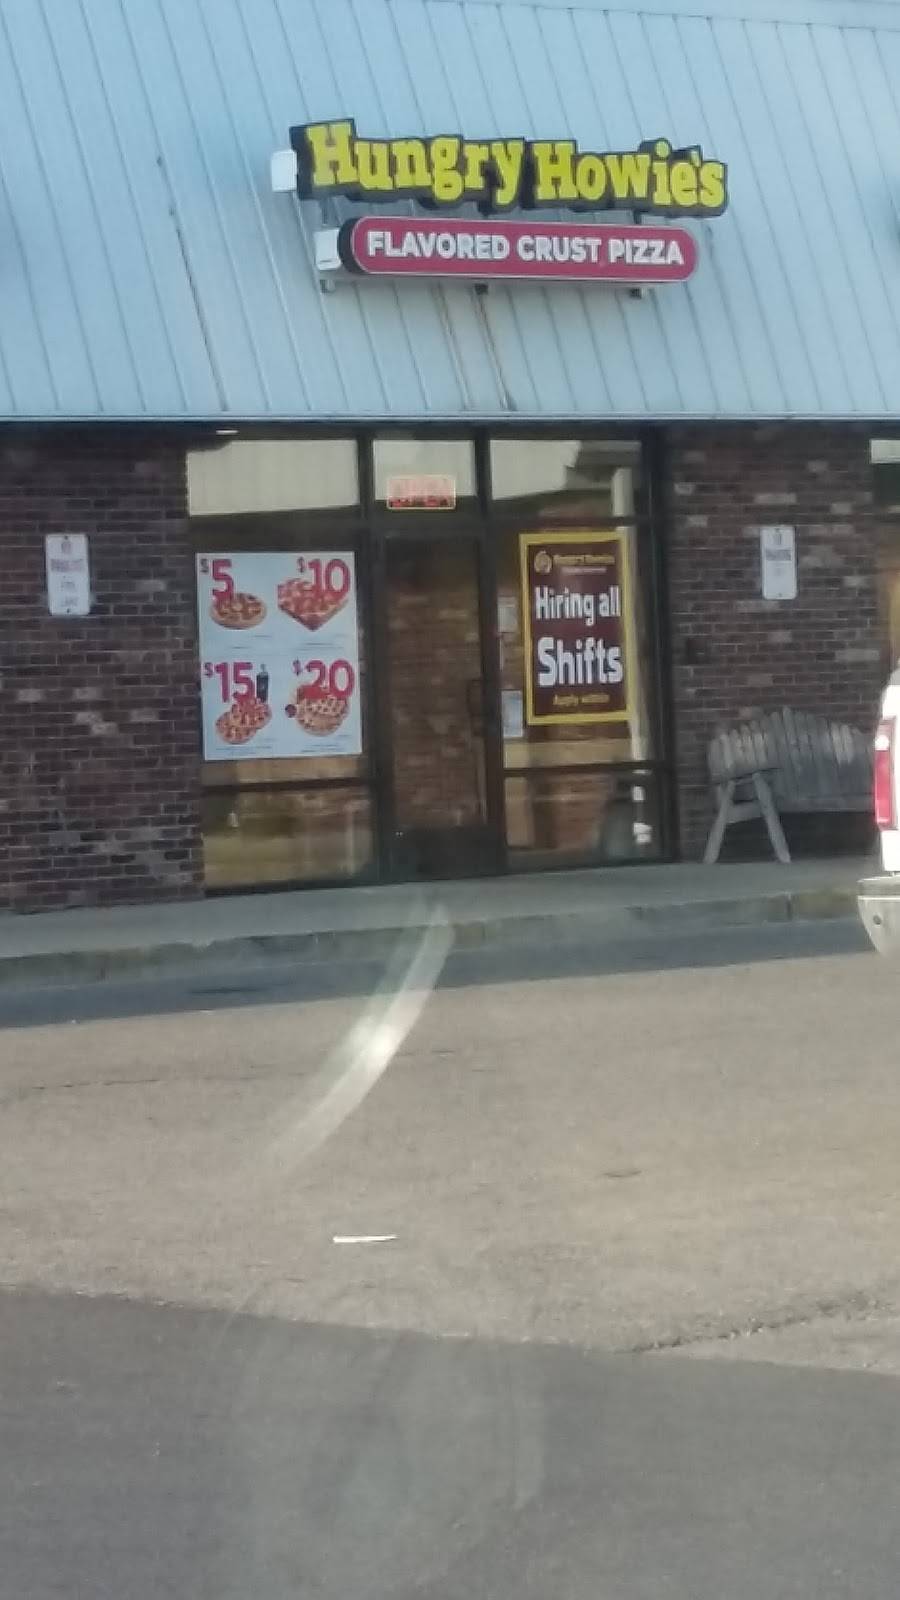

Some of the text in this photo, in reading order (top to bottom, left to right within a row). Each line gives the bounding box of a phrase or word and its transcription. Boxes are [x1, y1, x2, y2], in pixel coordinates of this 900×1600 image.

[305, 120, 727, 208] Hungry Howie's
[366, 229, 685, 267] FLAVORED CRUST PIZZA
[200, 558, 234, 602] $5
[297, 556, 350, 598] $10
[534, 585, 621, 627] Hiring all
[204, 661, 256, 703] $15
[293, 658, 355, 701] $20
[537, 636, 624, 688] Shifts
